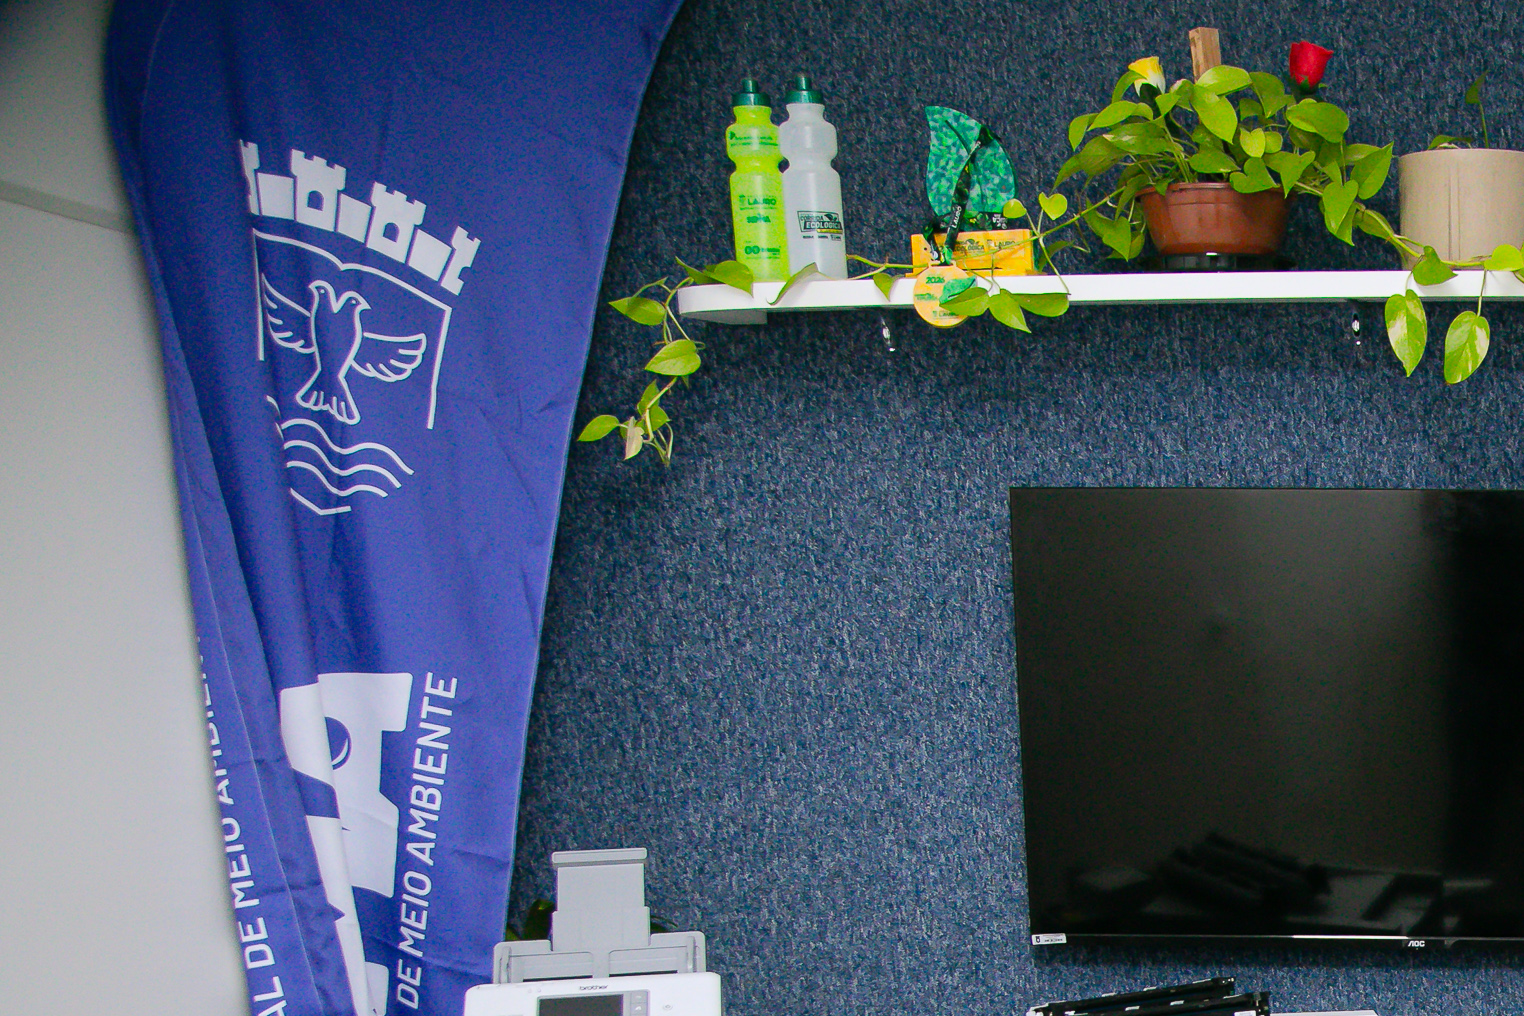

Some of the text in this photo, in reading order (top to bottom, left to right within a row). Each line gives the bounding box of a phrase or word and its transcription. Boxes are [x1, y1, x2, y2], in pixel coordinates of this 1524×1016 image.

[406, 671, 458, 866] AMBIENTE
[222, 817, 260, 910] MEIO
[399, 871, 432, 957] MEIO
[238, 917, 275, 969] DE
[1407, 940, 1425, 948] AOC
[396, 958, 423, 1011] DE
[579, 984, 608, 992] brother
